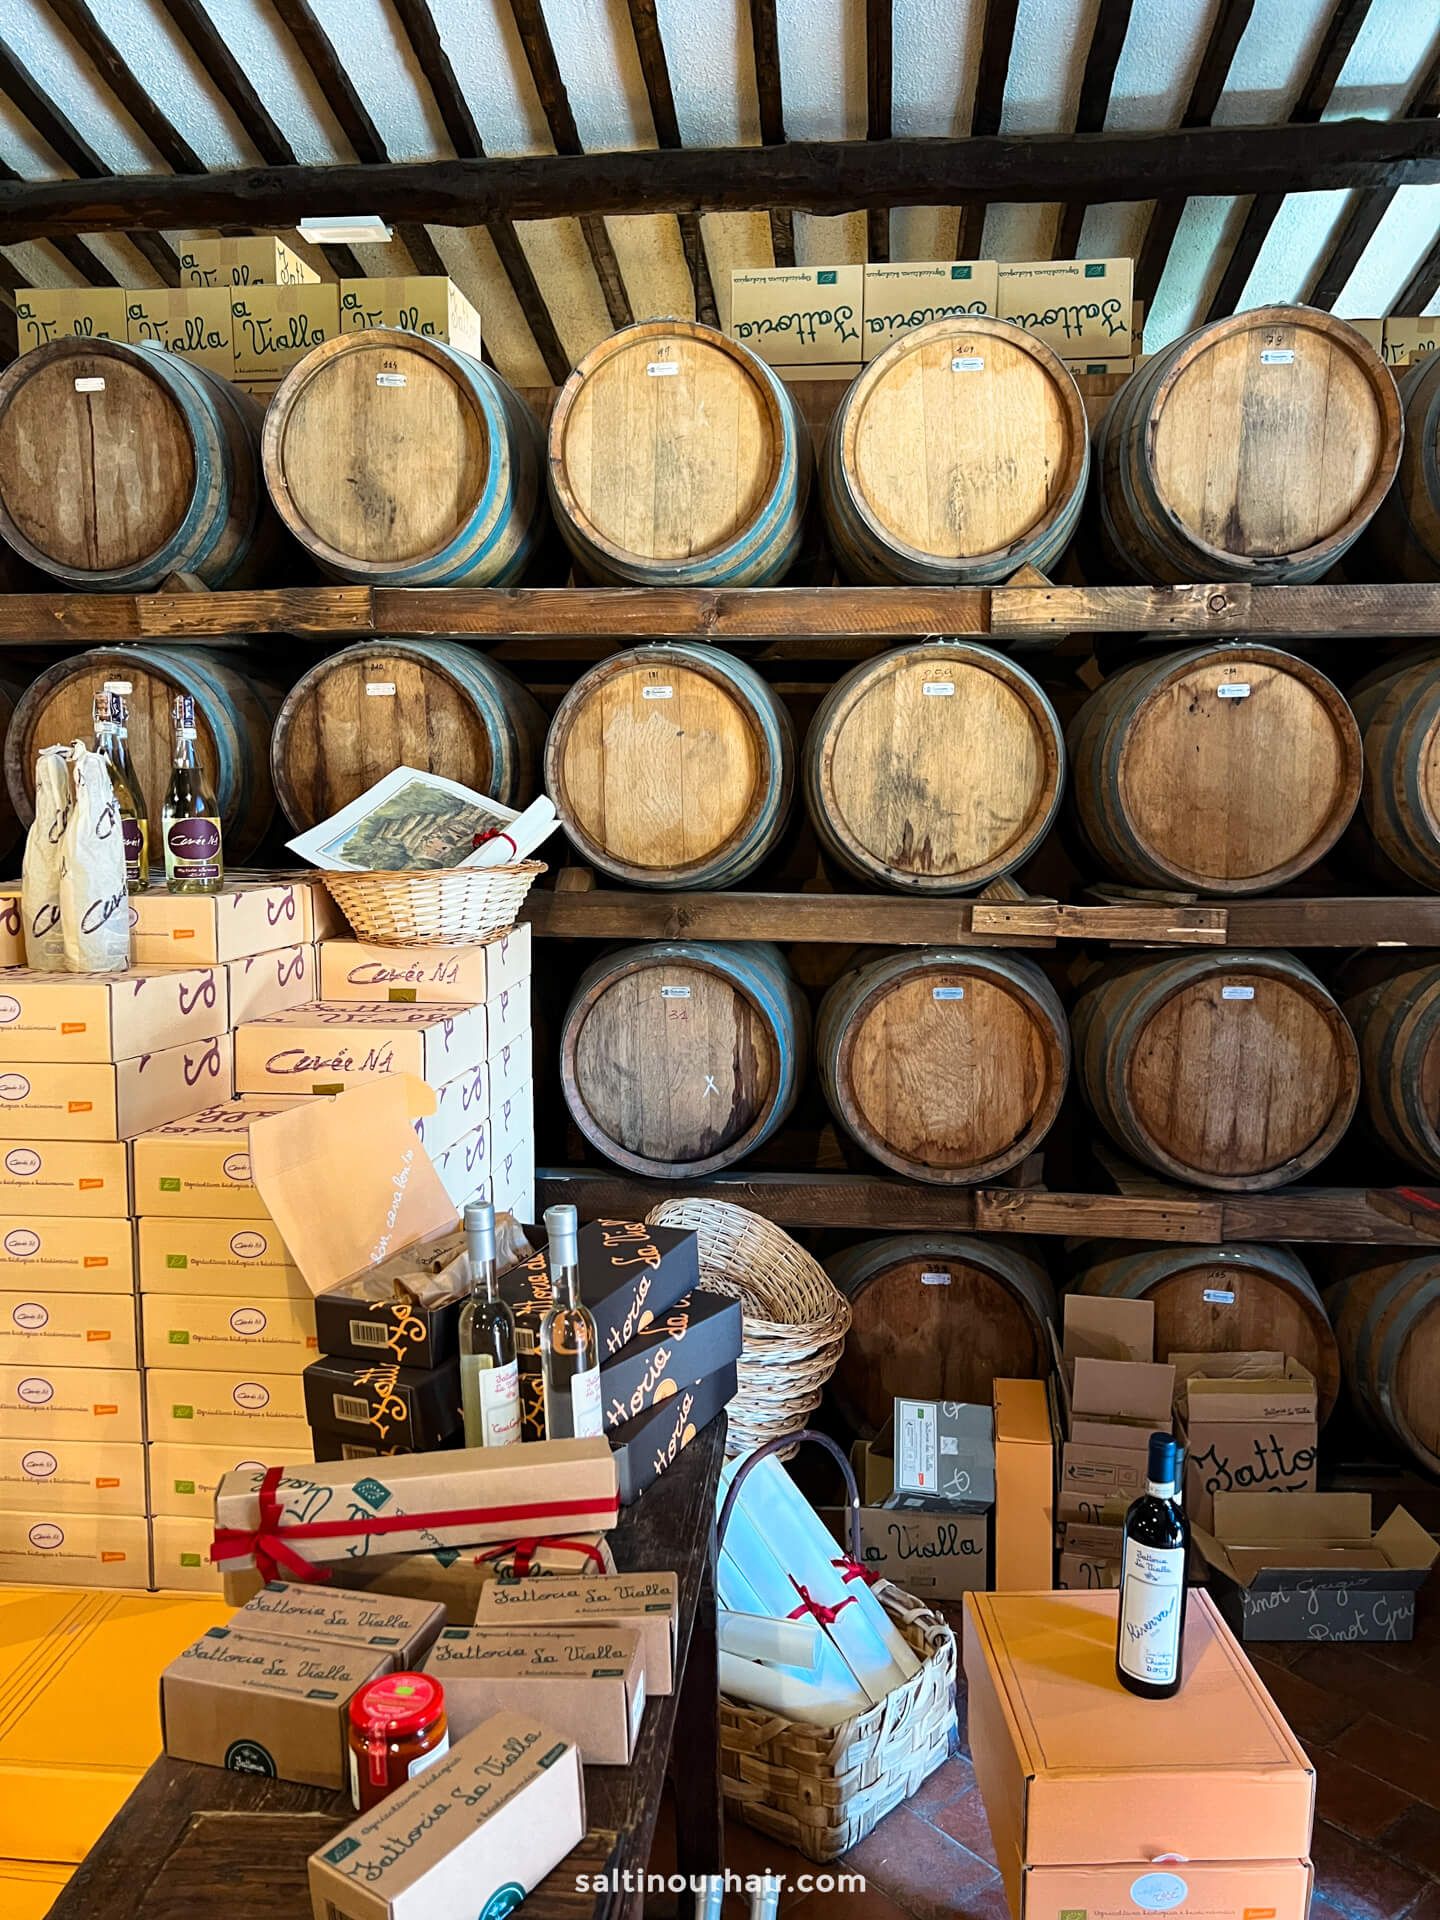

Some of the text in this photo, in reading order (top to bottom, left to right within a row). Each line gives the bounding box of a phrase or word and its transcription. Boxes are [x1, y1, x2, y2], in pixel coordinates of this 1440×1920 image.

[242, 314, 325, 355] Vialla
[733, 305, 860, 345] Fattoria
[347, 961, 425, 985] Cuvée
[265, 1048, 355, 1075] Cuvée
[887, 1523, 984, 1560] Vialla
[244, 1595, 326, 1616] Fattoria
[493, 1583, 672, 1604] Fattoria La Vialla
[323, 1610, 412, 1629] La Vialla
[181, 1642, 265, 1665] Fattoria
[435, 1644, 628, 1664] Fattoria La Vialla
[262, 1657, 353, 1682] La Vialla
[348, 1801, 453, 1882] Fattoria
[474, 1730, 542, 1777] Vialla
